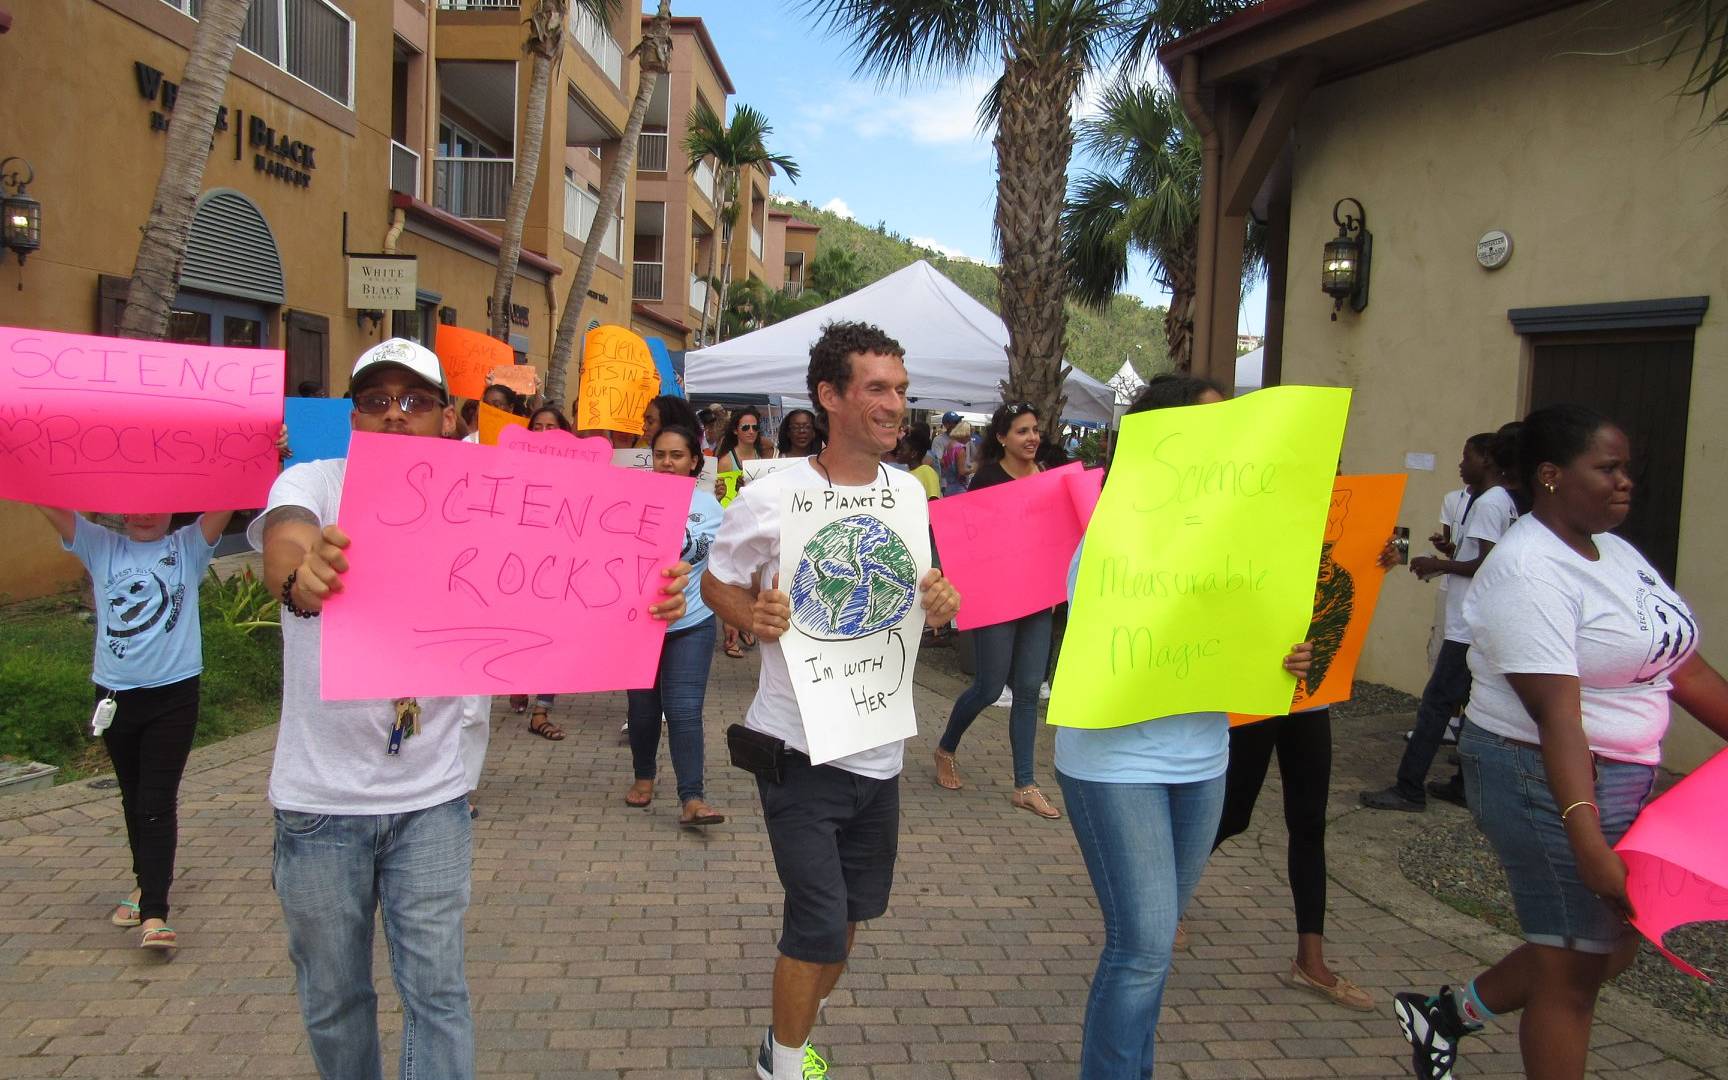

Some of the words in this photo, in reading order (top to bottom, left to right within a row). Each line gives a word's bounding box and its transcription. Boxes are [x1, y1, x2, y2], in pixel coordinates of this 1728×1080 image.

[134, 61, 229, 132] WHE
[250, 115, 317, 170] BLACK
[362, 266, 404, 278] WHITE
[362, 284, 401, 295] BLACK
[10, 338, 276, 396] SCIENCE
[622, 367, 638, 383] IN
[37, 414, 220, 465] ROCKS!
[1133, 432, 1277, 512] Science
[376, 461, 666, 547] SCIENCE
[447, 547, 661, 622] ROCKS!
